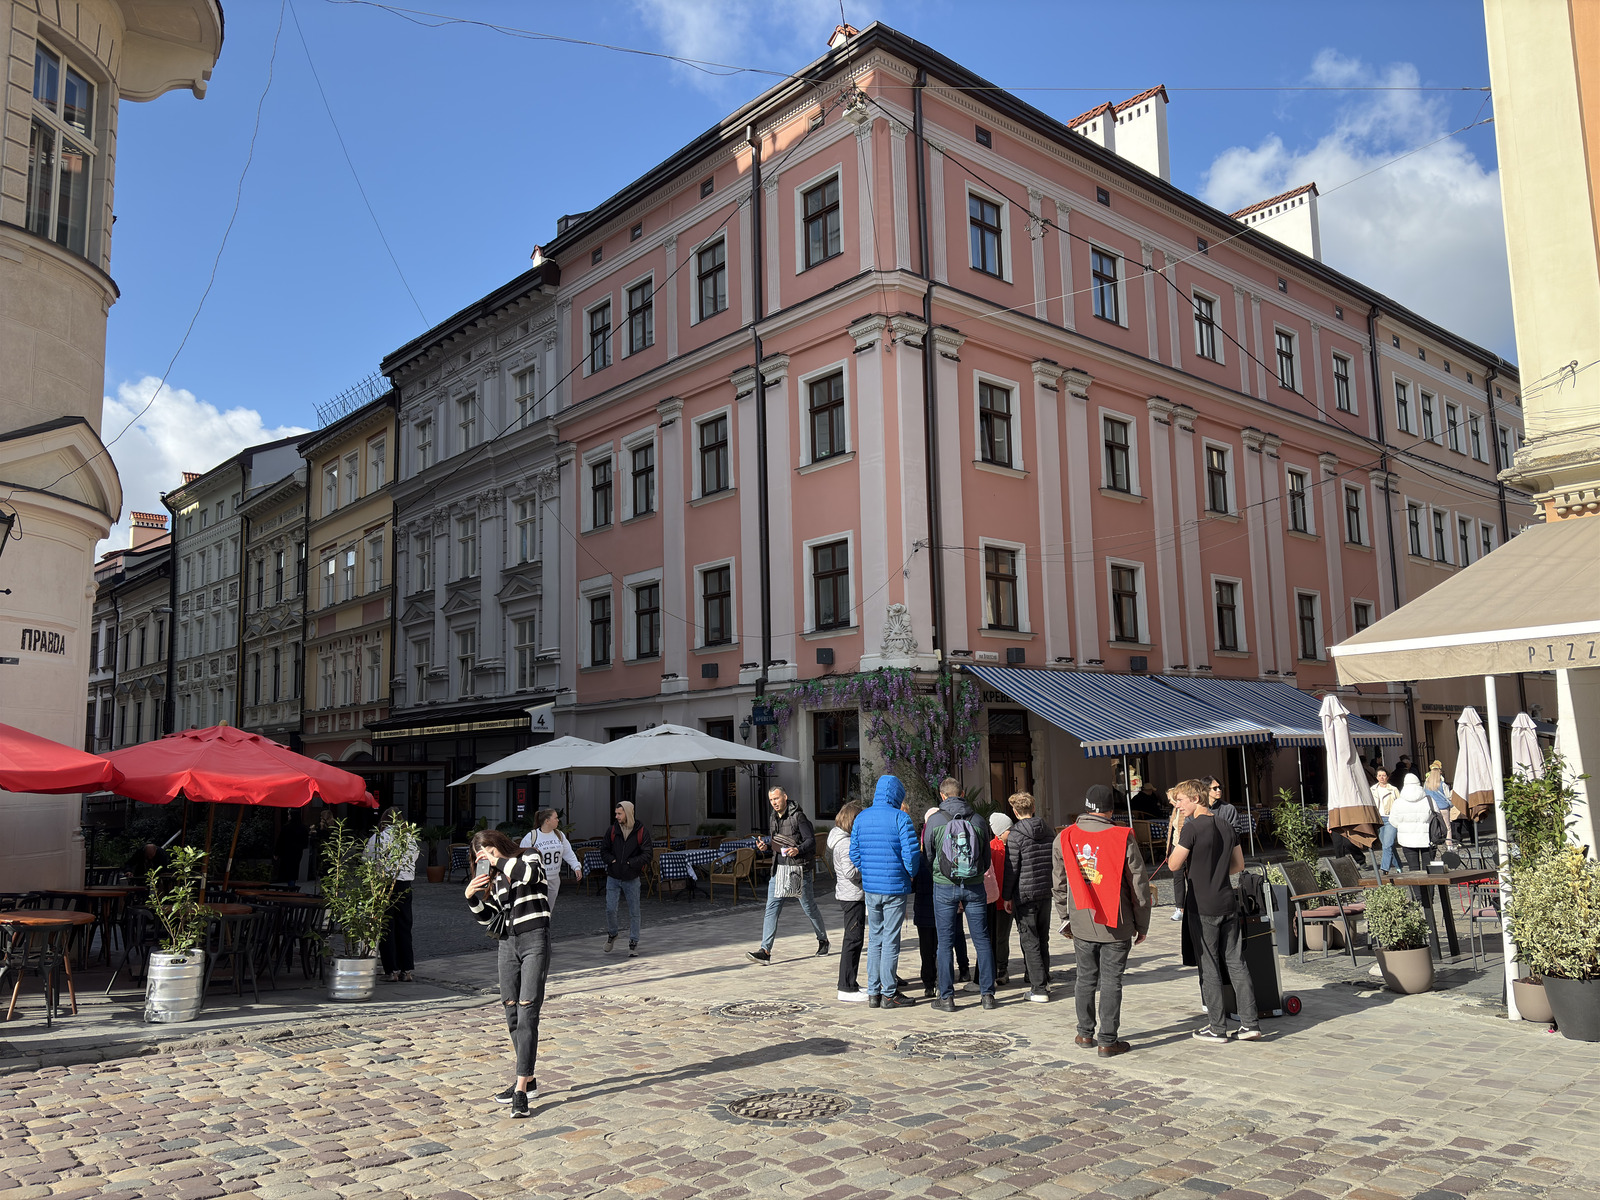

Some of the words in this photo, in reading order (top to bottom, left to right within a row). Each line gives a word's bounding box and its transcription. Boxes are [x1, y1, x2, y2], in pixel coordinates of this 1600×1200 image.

[537, 714, 546, 726] 4
[534, 839, 561, 849] BROOKLY
[544, 851, 561, 865] 86
